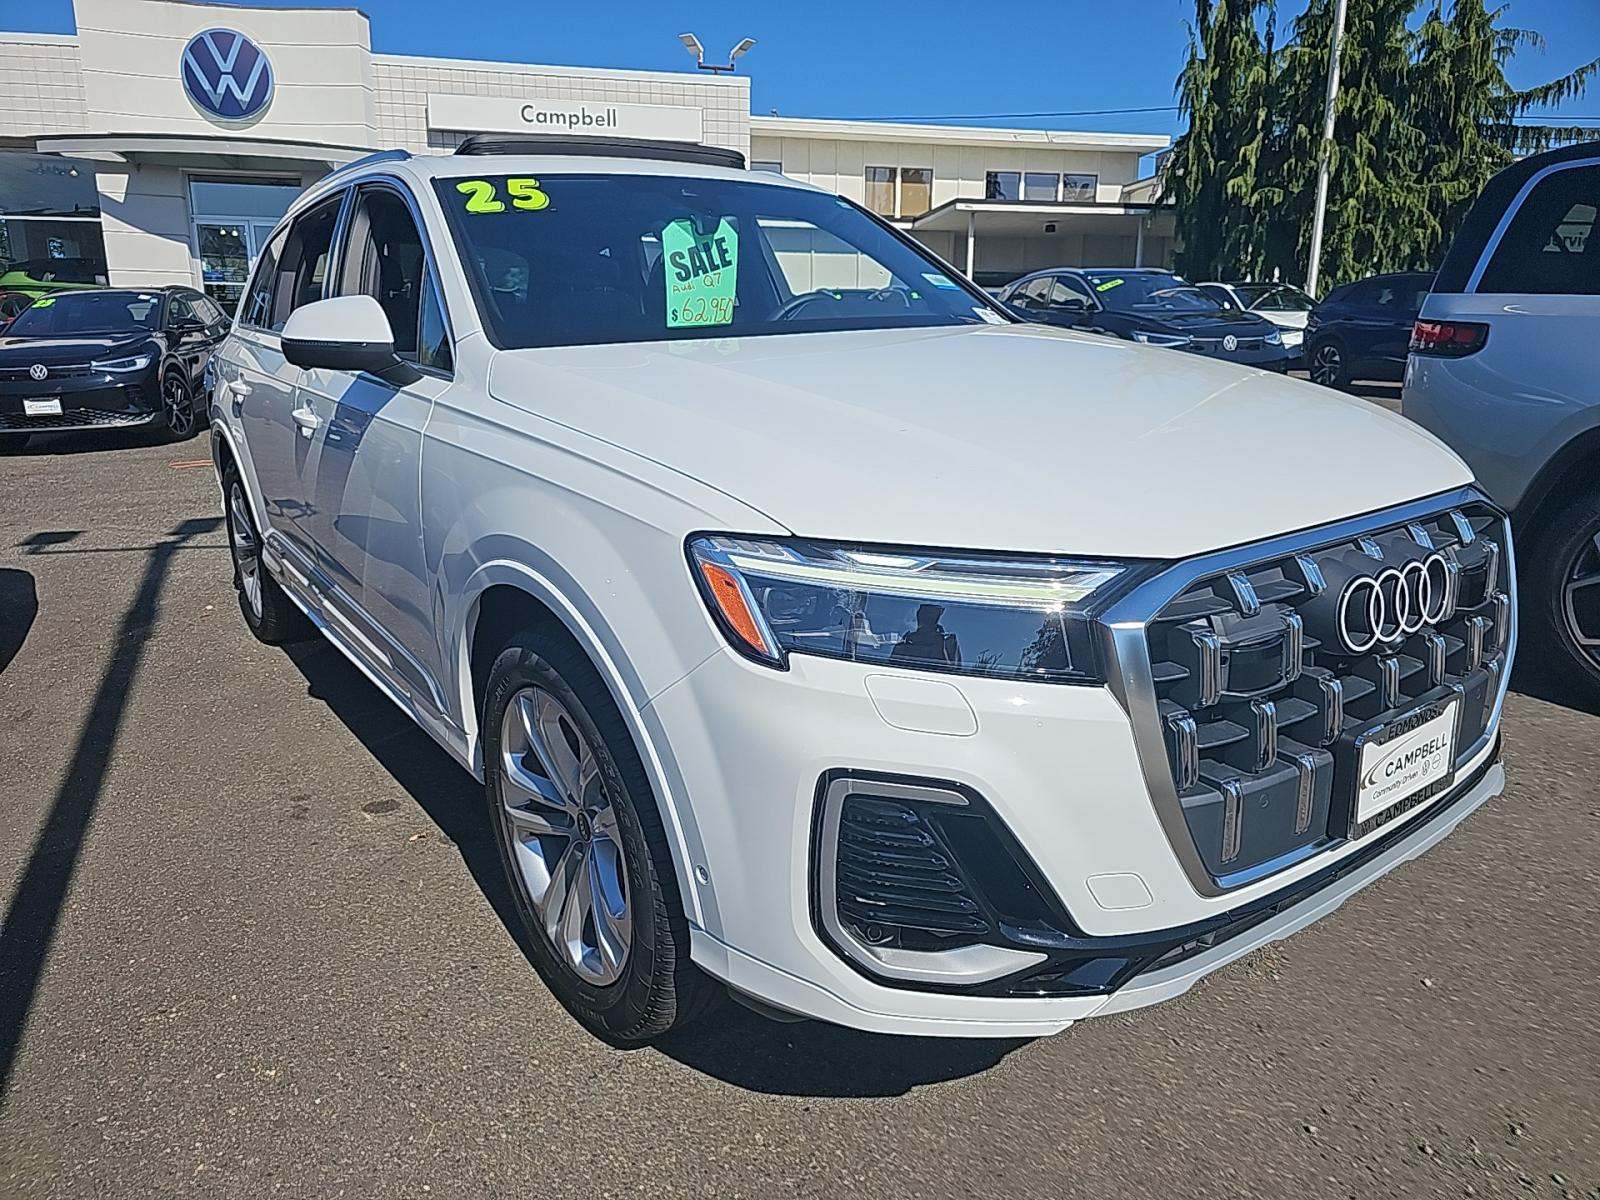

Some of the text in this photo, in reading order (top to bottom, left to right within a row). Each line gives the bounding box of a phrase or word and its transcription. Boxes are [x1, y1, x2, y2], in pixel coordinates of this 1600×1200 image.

[521, 104, 617, 129] Campbell
[456, 178, 550, 213] 25
[669, 237, 733, 282] SALE
[703, 272, 722, 287] Q7
[1385, 733, 1447, 777] CAMPBELL
